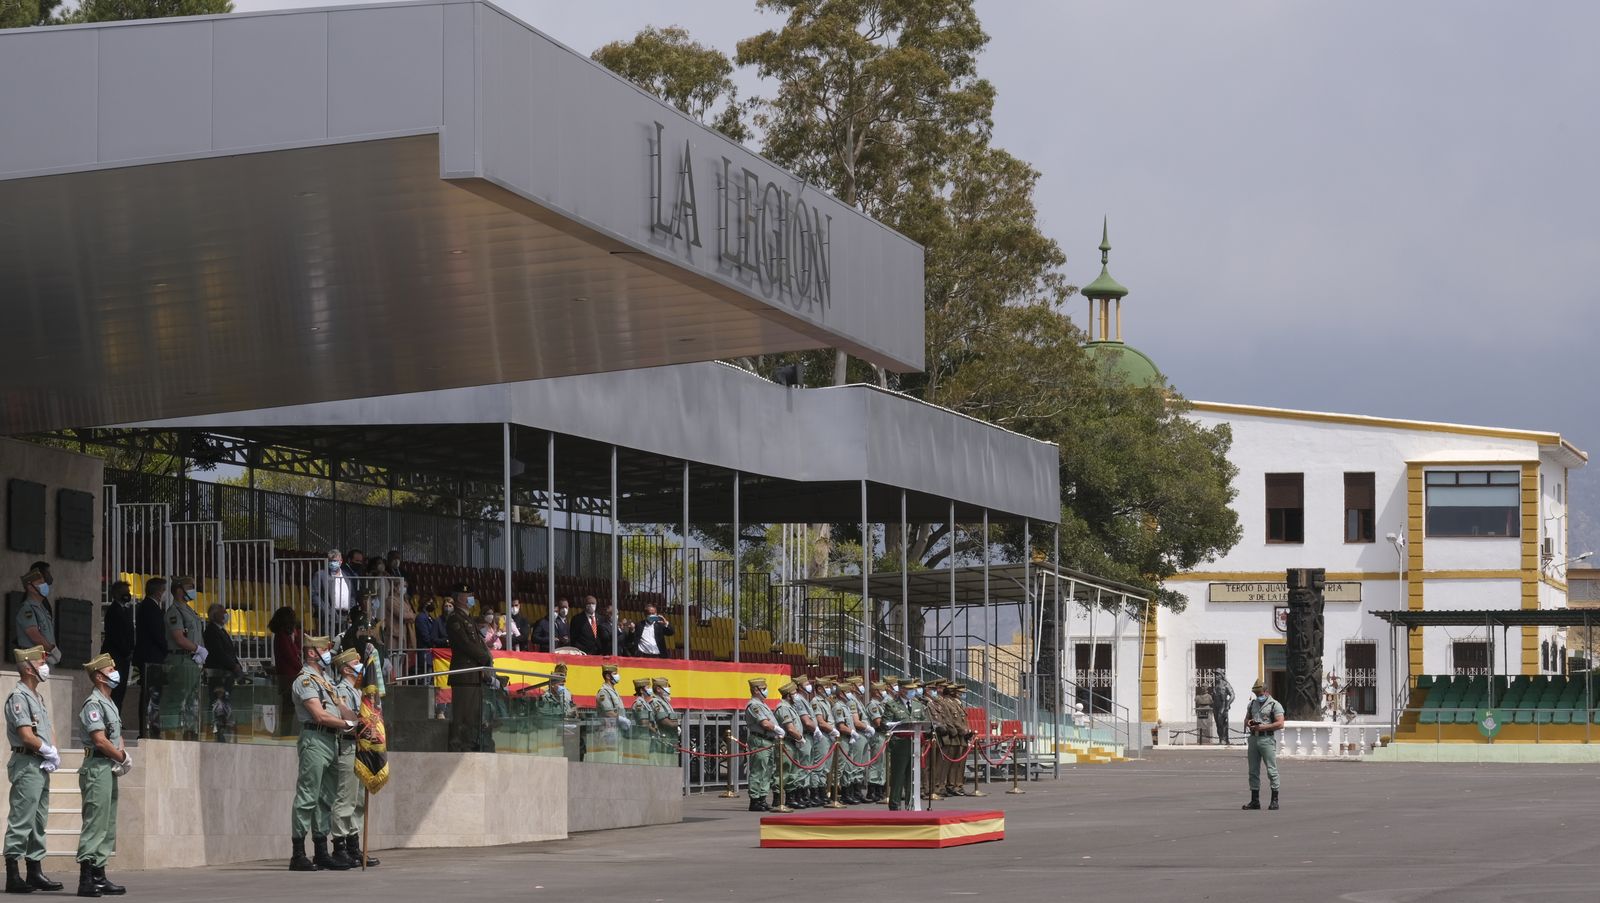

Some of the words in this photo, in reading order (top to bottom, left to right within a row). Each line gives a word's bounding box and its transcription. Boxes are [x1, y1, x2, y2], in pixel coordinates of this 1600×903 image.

[653, 121, 703, 248] LA
[720, 156, 833, 310] LEGIÓN
[1226, 584, 1254, 592] TERCIO
[1266, 584, 1286, 592] JUAN
